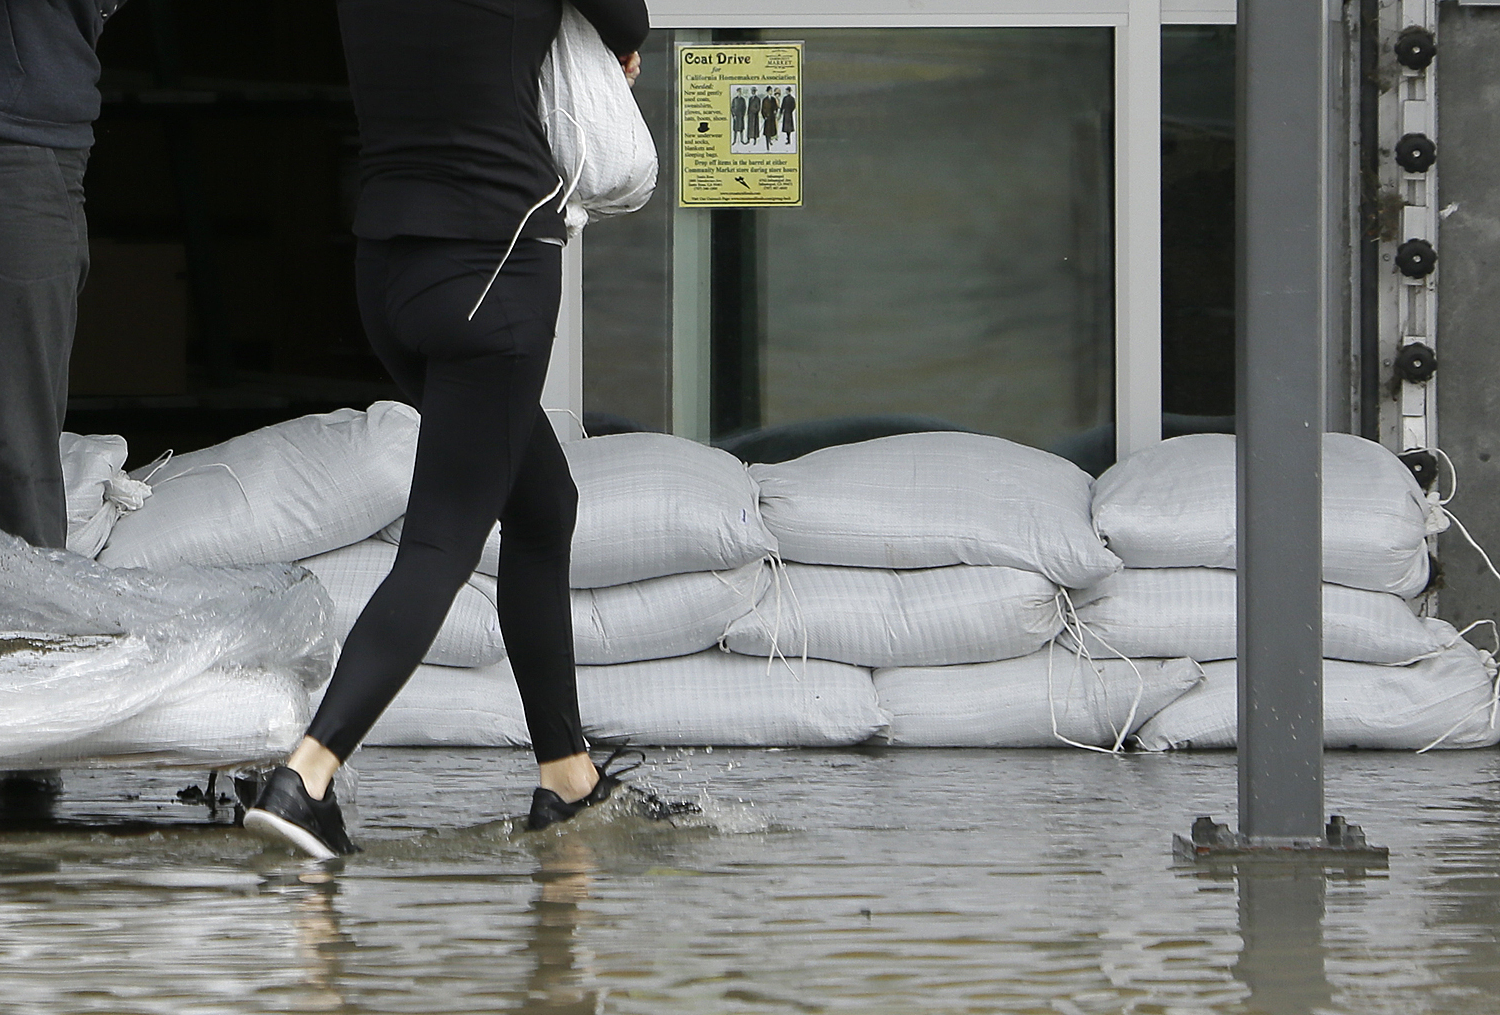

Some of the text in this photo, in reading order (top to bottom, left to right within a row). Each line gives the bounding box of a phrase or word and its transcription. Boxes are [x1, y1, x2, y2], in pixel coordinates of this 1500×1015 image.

[684, 52, 751, 65] Coat Drive
[711, 66, 722, 74] for
[694, 159, 708, 167] Drop
[684, 167, 715, 175] Community
[751, 167, 768, 175] during
